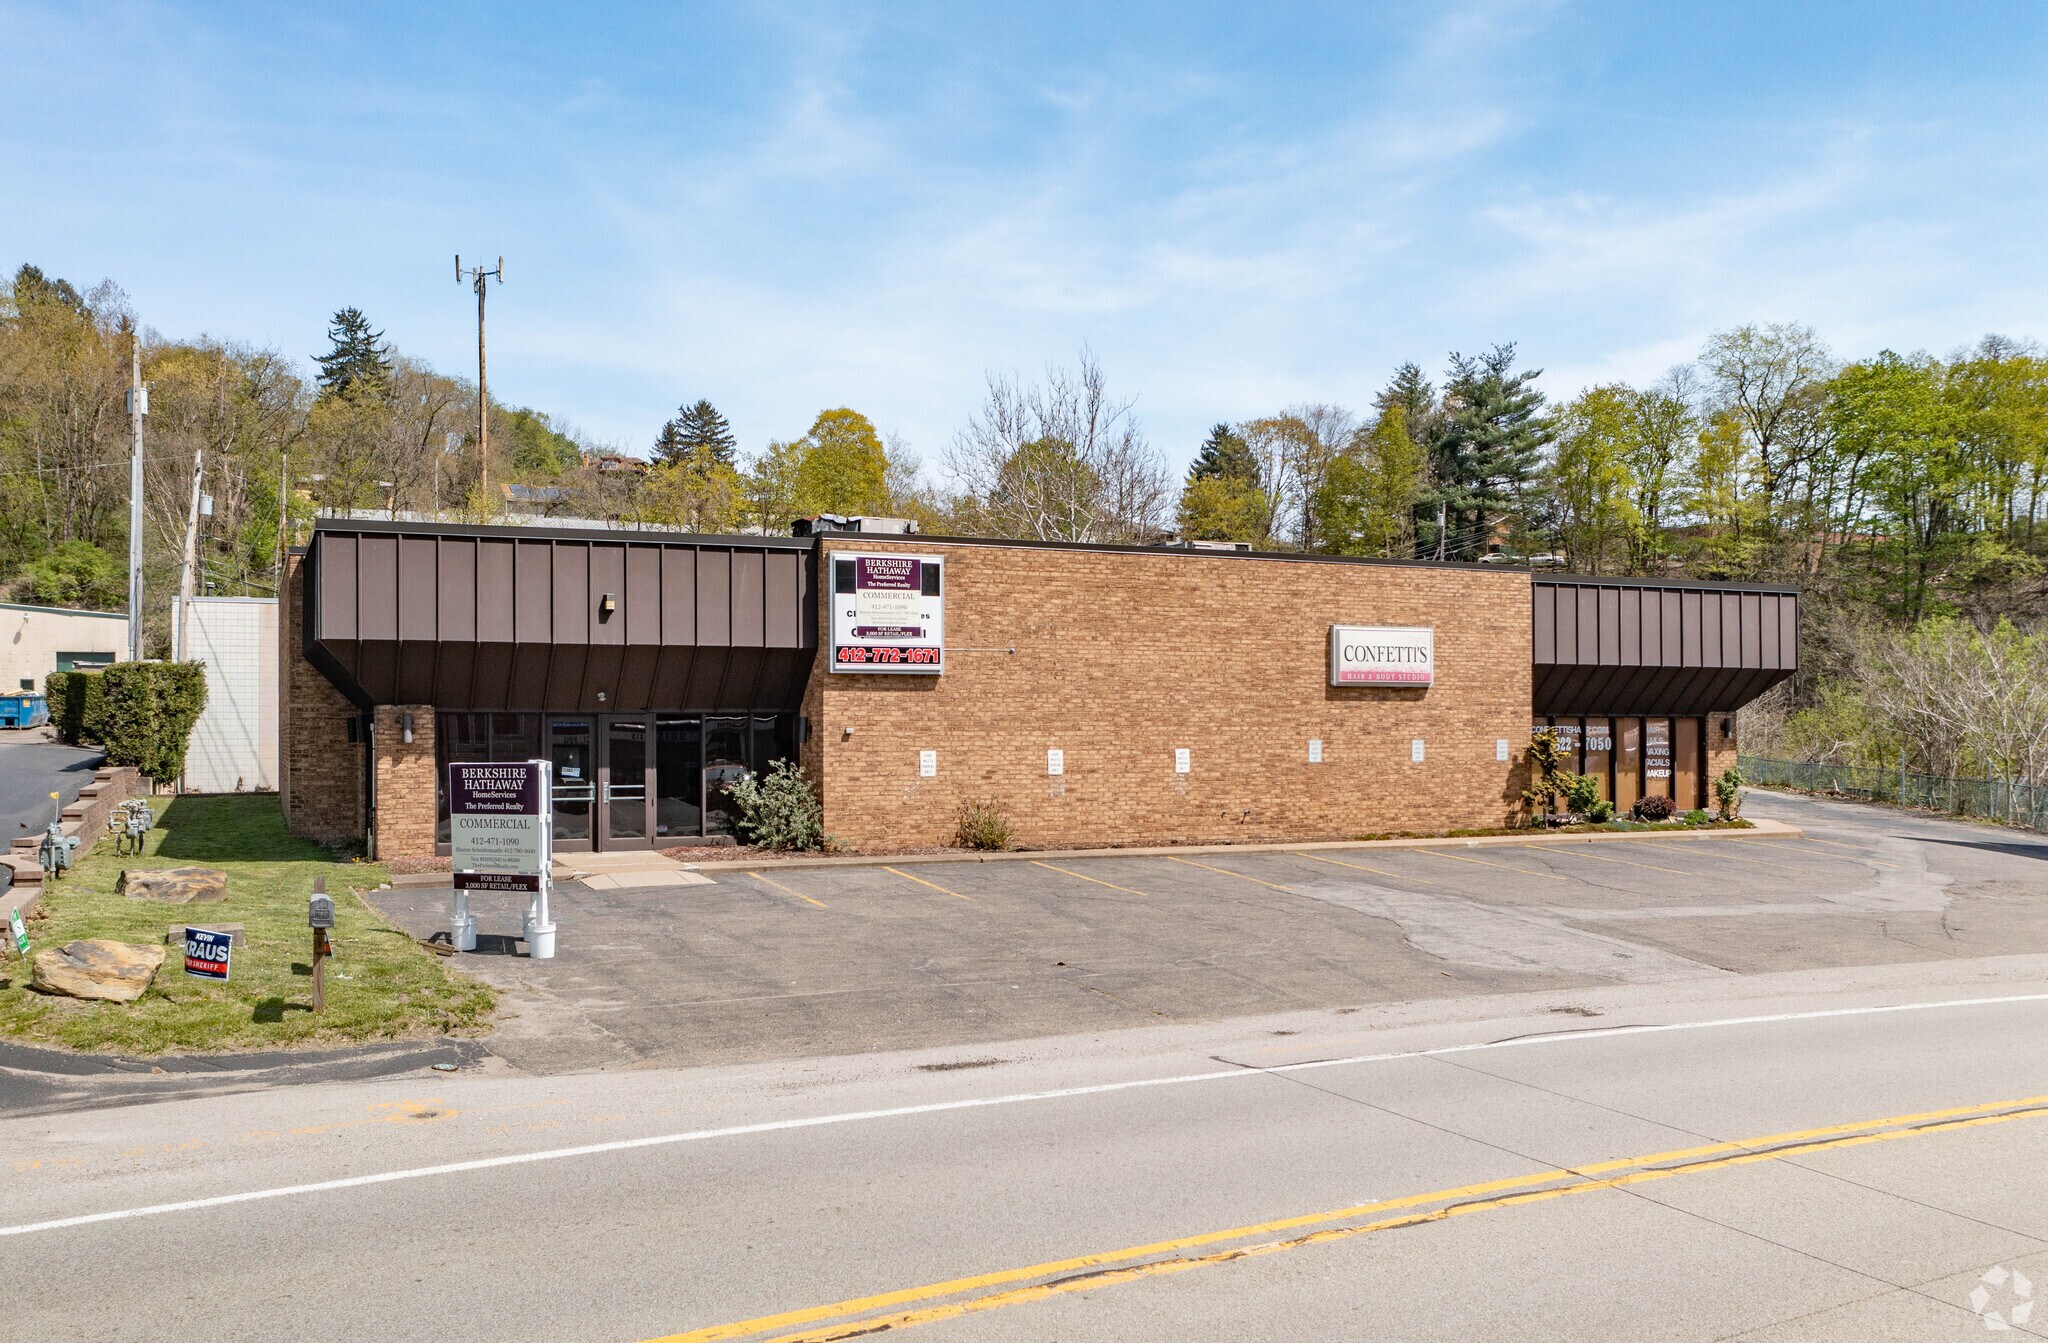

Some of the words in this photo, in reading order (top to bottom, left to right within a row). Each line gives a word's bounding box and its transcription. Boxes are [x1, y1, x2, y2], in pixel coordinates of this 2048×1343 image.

[865, 559, 913, 568] BERKSHIRE
[866, 566, 911, 575] HATHAWAY
[862, 592, 915, 600] COMMERCIAL
[838, 647, 939, 663] 412-772-1671
[1344, 645, 1428, 663] CONFETTI'S
[1347, 672, 1365, 680] HAIR
[1398, 673, 1425, 681] STUDIO
[461, 767, 527, 779] BERKSHIRE
[464, 779, 525, 790] HATHAWAY
[472, 790, 517, 799] HomeServices
[465, 802, 477, 810] The
[477, 802, 505, 810] Preferred
[505, 803, 524, 811] Realty
[459, 818, 531, 830] COMMERCIAL
[470, 837, 520, 846] 412-471-1090
[464, 882, 480, 890] 3,000
[489, 883, 528, 891] RETAIL/FLEX
[195, 933, 214, 942] KEVIN
[192, 960, 218, 970] SHERIFF
